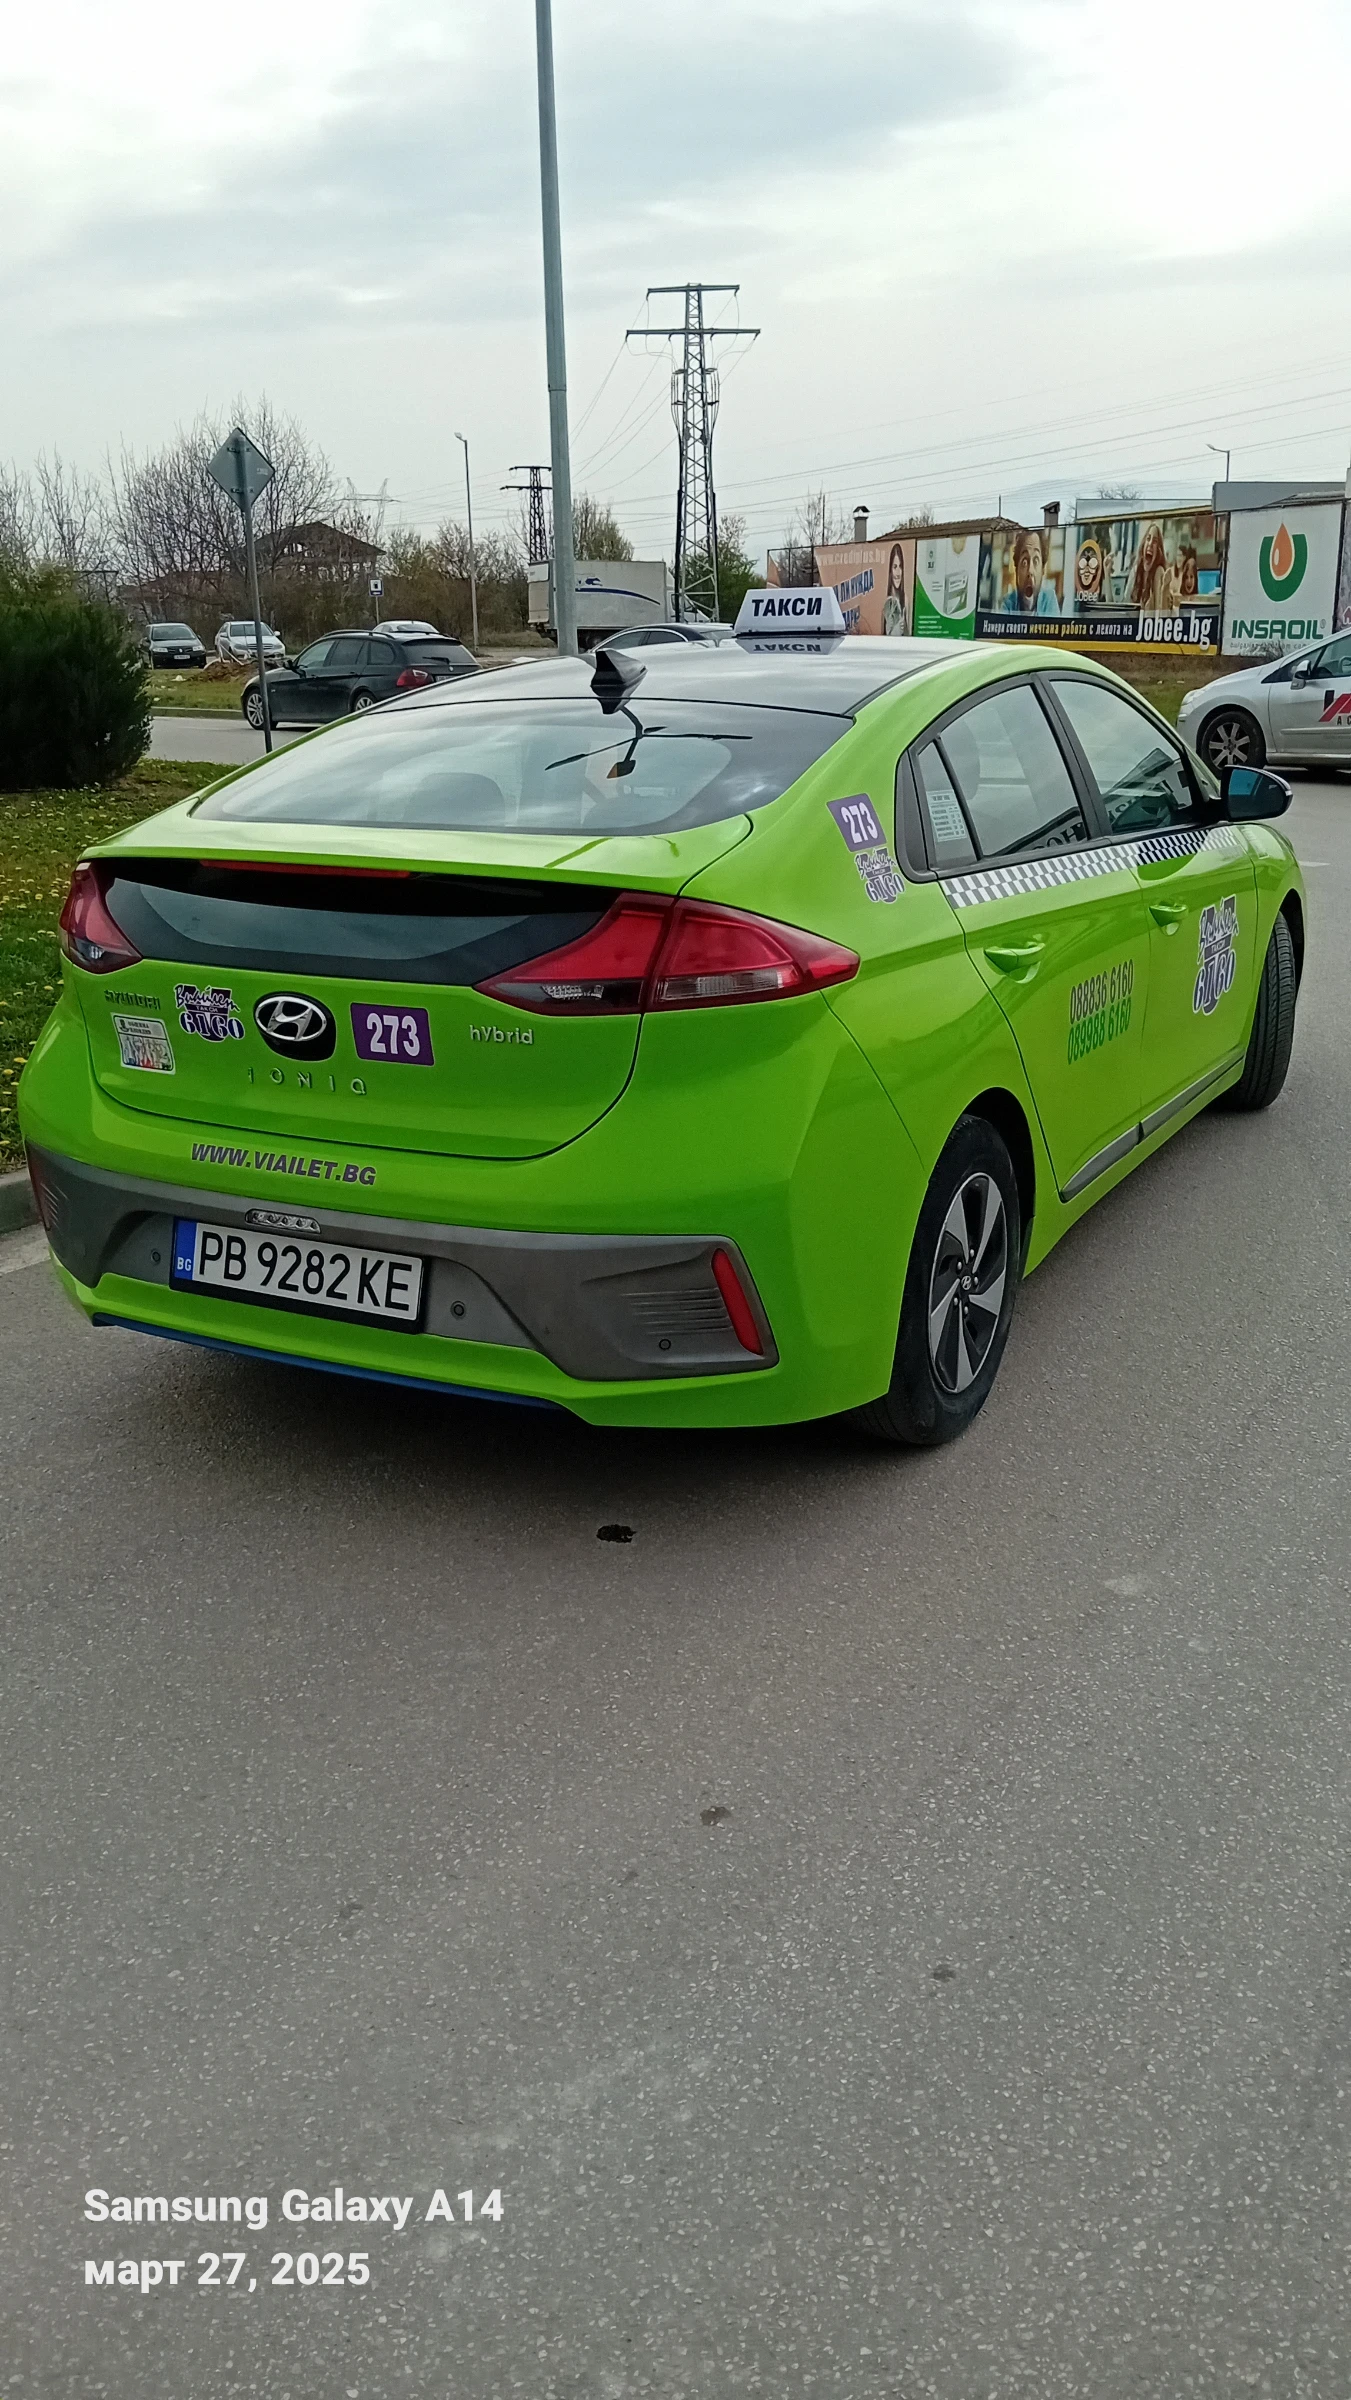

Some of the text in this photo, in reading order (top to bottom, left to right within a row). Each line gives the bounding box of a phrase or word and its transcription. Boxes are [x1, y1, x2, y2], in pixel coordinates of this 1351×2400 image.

[751, 597, 823, 617] ТАКСИ
[983, 619, 1006, 636] Намери
[1029, 623, 1059, 635] мечтана
[1061, 620, 1087, 637] работа
[1089, 624, 1094, 635] с
[1096, 623, 1121, 636] лекота
[1123, 624, 1133, 635] на
[1136, 609, 1213, 651] Jobee.bg
[1231, 619, 1324, 640] INSAOIL
[840, 802, 878, 844] 273
[865, 873, 905, 902] 6160
[1070, 959, 1134, 1025] 088836 6160
[1193, 949, 1236, 1014] 6160
[179, 1011, 245, 1040] 6160
[366, 1013, 420, 1057] 273
[469, 1024, 534, 1045] hybrid
[1068, 997, 1132, 1065] 089988 6160
[248, 1067, 368, 1096] IONIQ
[191, 1142, 377, 1186] WWW.VIAILET.BG
[176, 1256, 192, 1272] BG
[199, 1231, 413, 1312] PB 9282 KE
